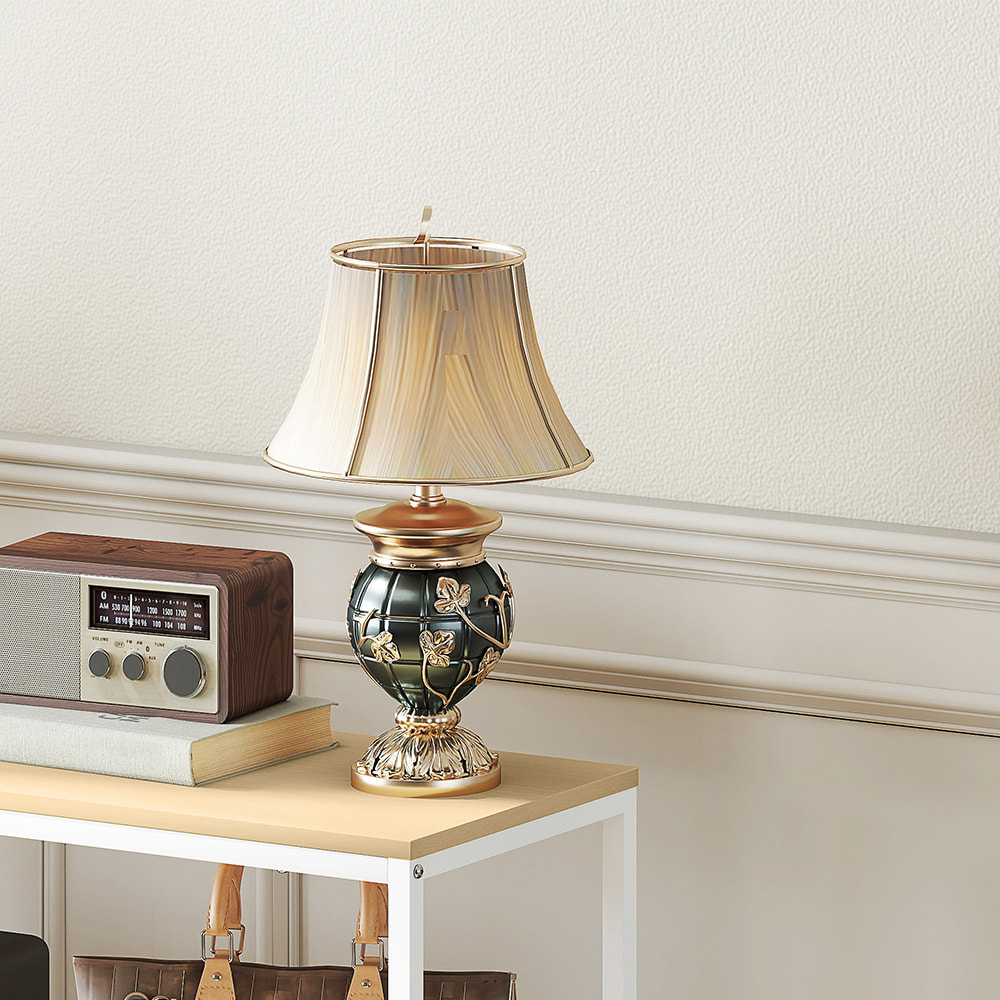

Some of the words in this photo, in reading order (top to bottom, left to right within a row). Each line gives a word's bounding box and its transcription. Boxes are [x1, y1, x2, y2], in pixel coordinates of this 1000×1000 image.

[147, 606, 158, 614] 1200
[162, 608, 173, 616] 1500
[176, 609, 187, 617] 1700
[164, 621, 173, 629] 104
